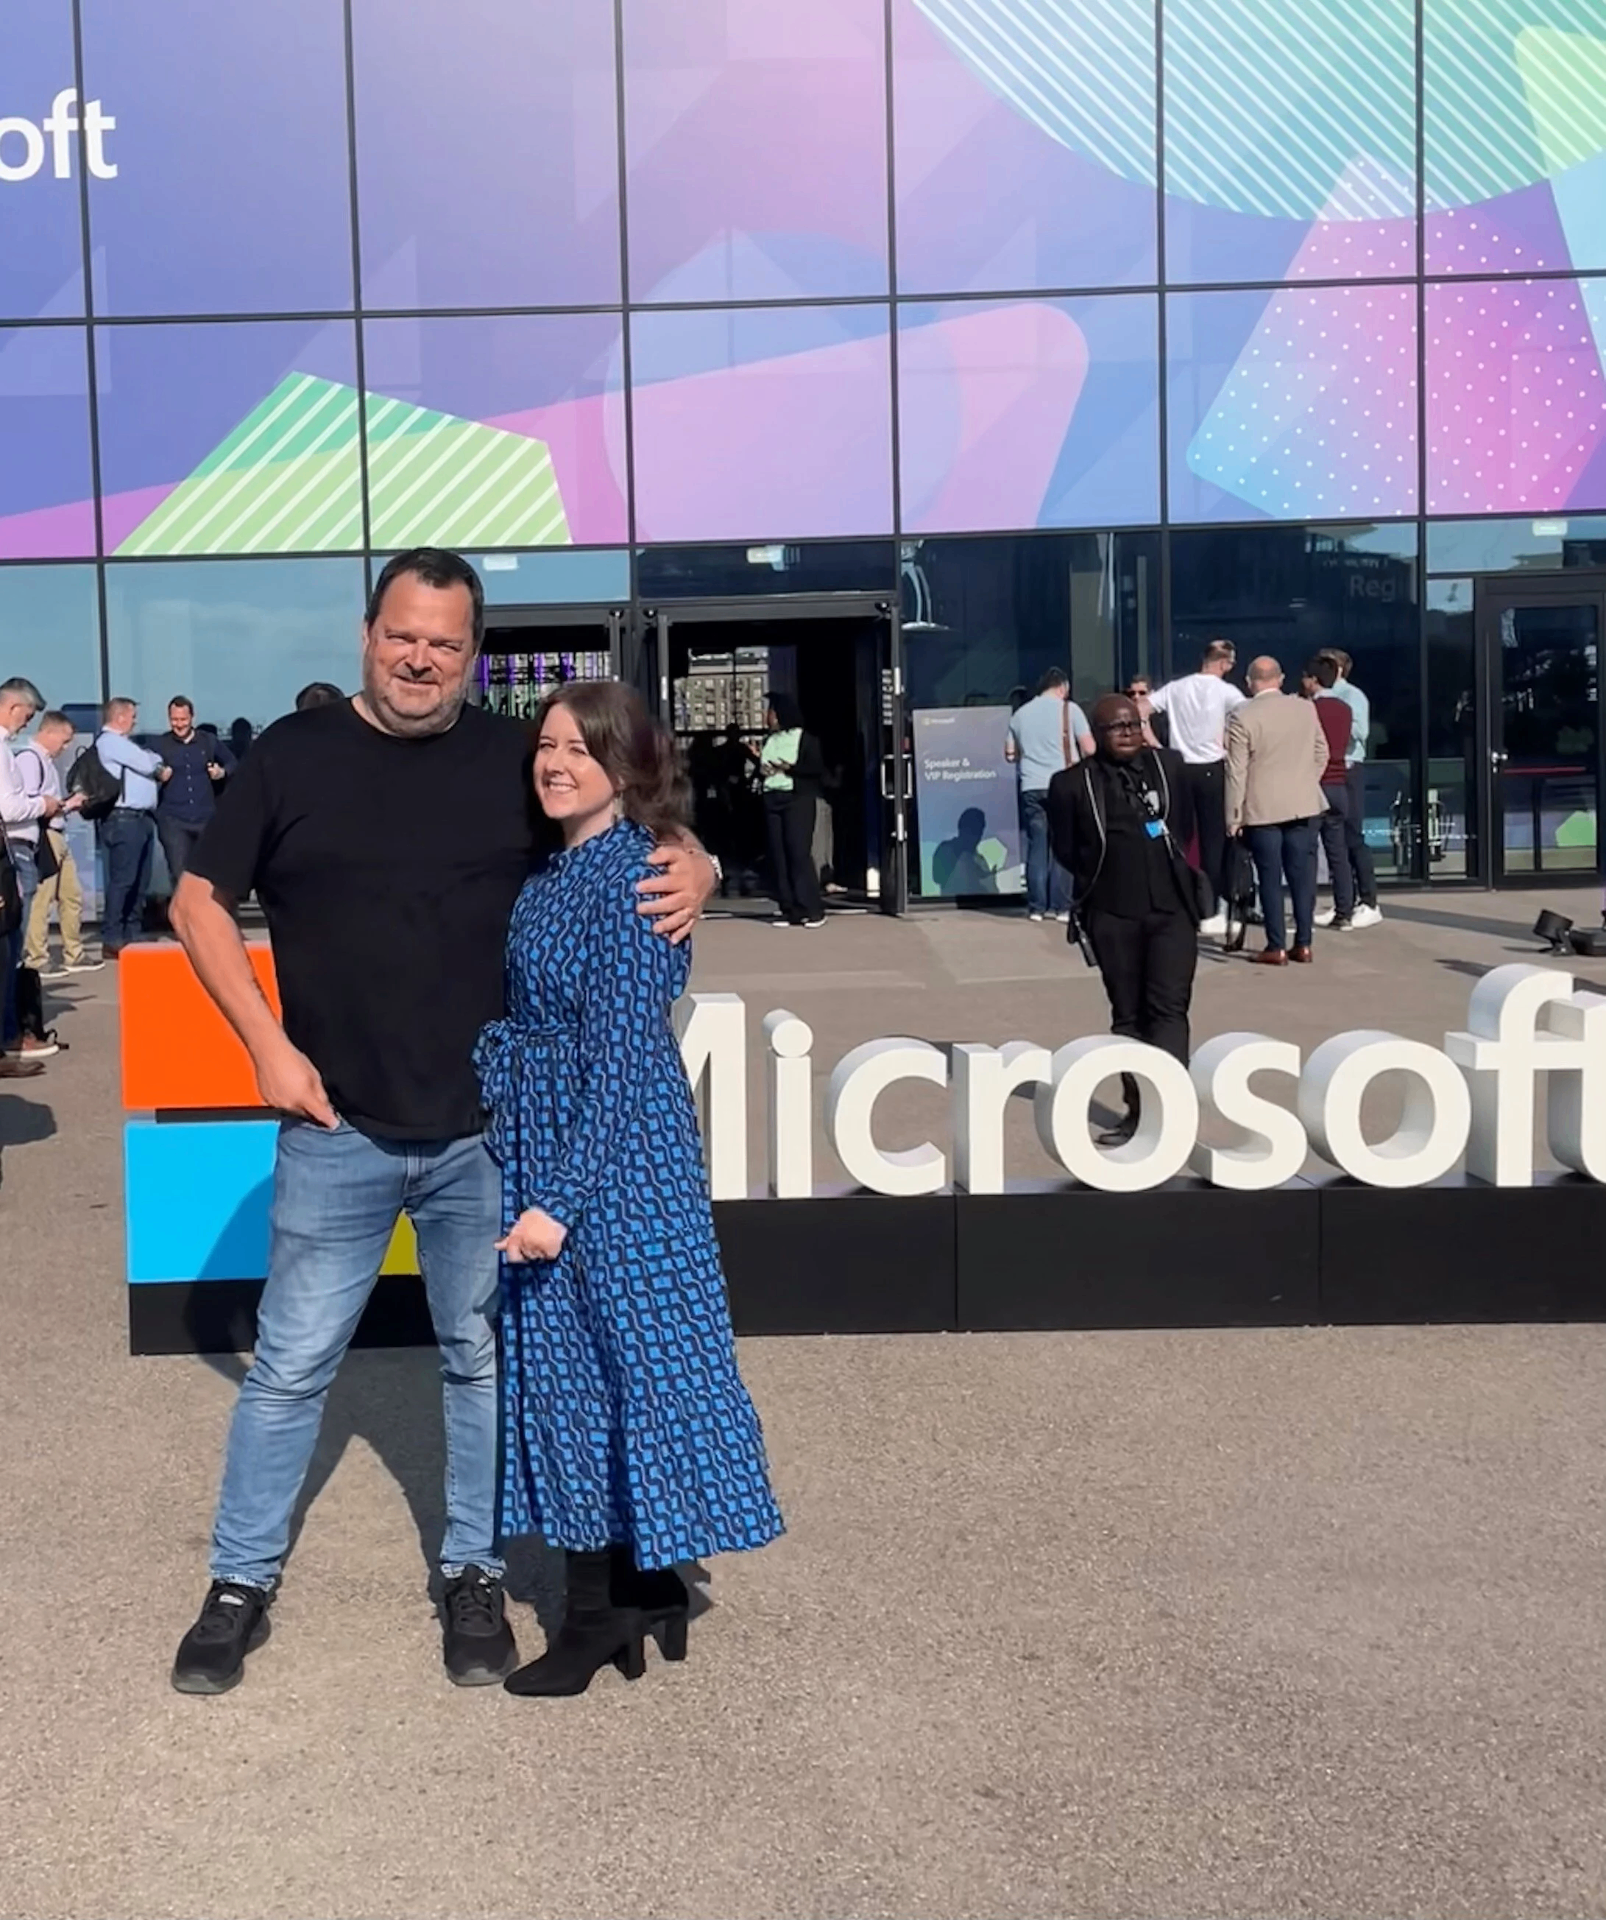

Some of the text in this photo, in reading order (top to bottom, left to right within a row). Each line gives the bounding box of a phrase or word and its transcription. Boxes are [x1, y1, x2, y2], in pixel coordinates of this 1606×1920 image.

[0, 87, 118, 180] oft
[924, 757, 971, 770] Speaker &
[924, 768, 997, 782] VIP Registration
